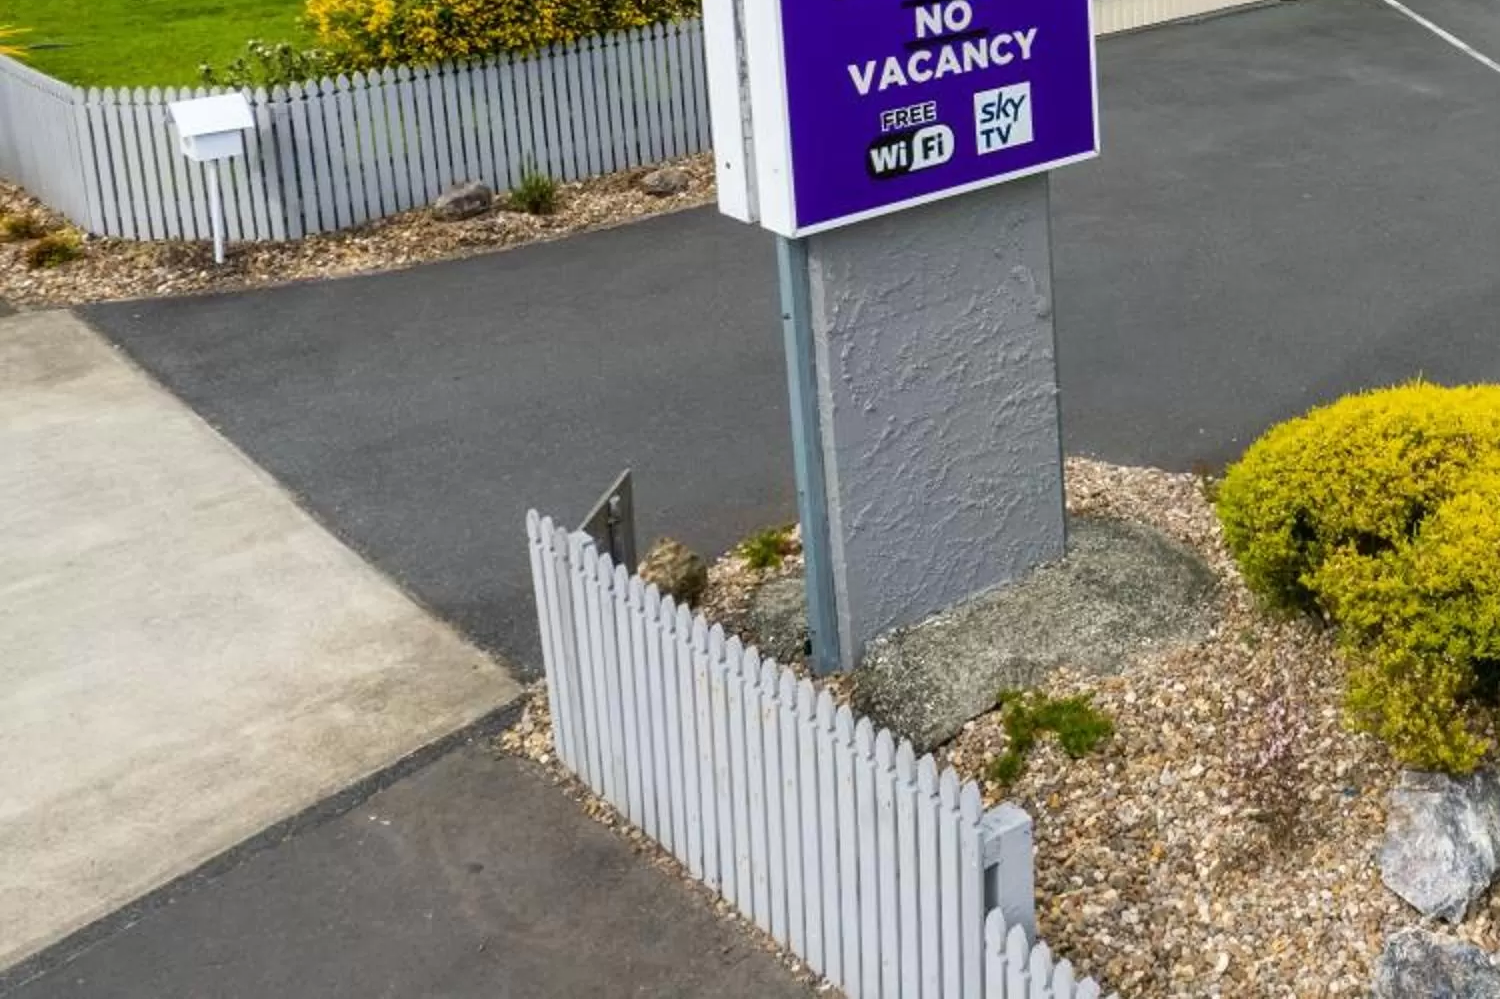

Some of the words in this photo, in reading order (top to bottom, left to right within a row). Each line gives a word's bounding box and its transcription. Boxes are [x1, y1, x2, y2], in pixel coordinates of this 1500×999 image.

[914, 0, 973, 38] NO
[847, 28, 1038, 96] VACANCY
[881, 101, 936, 131] FREE
[980, 123, 1012, 149] TV
